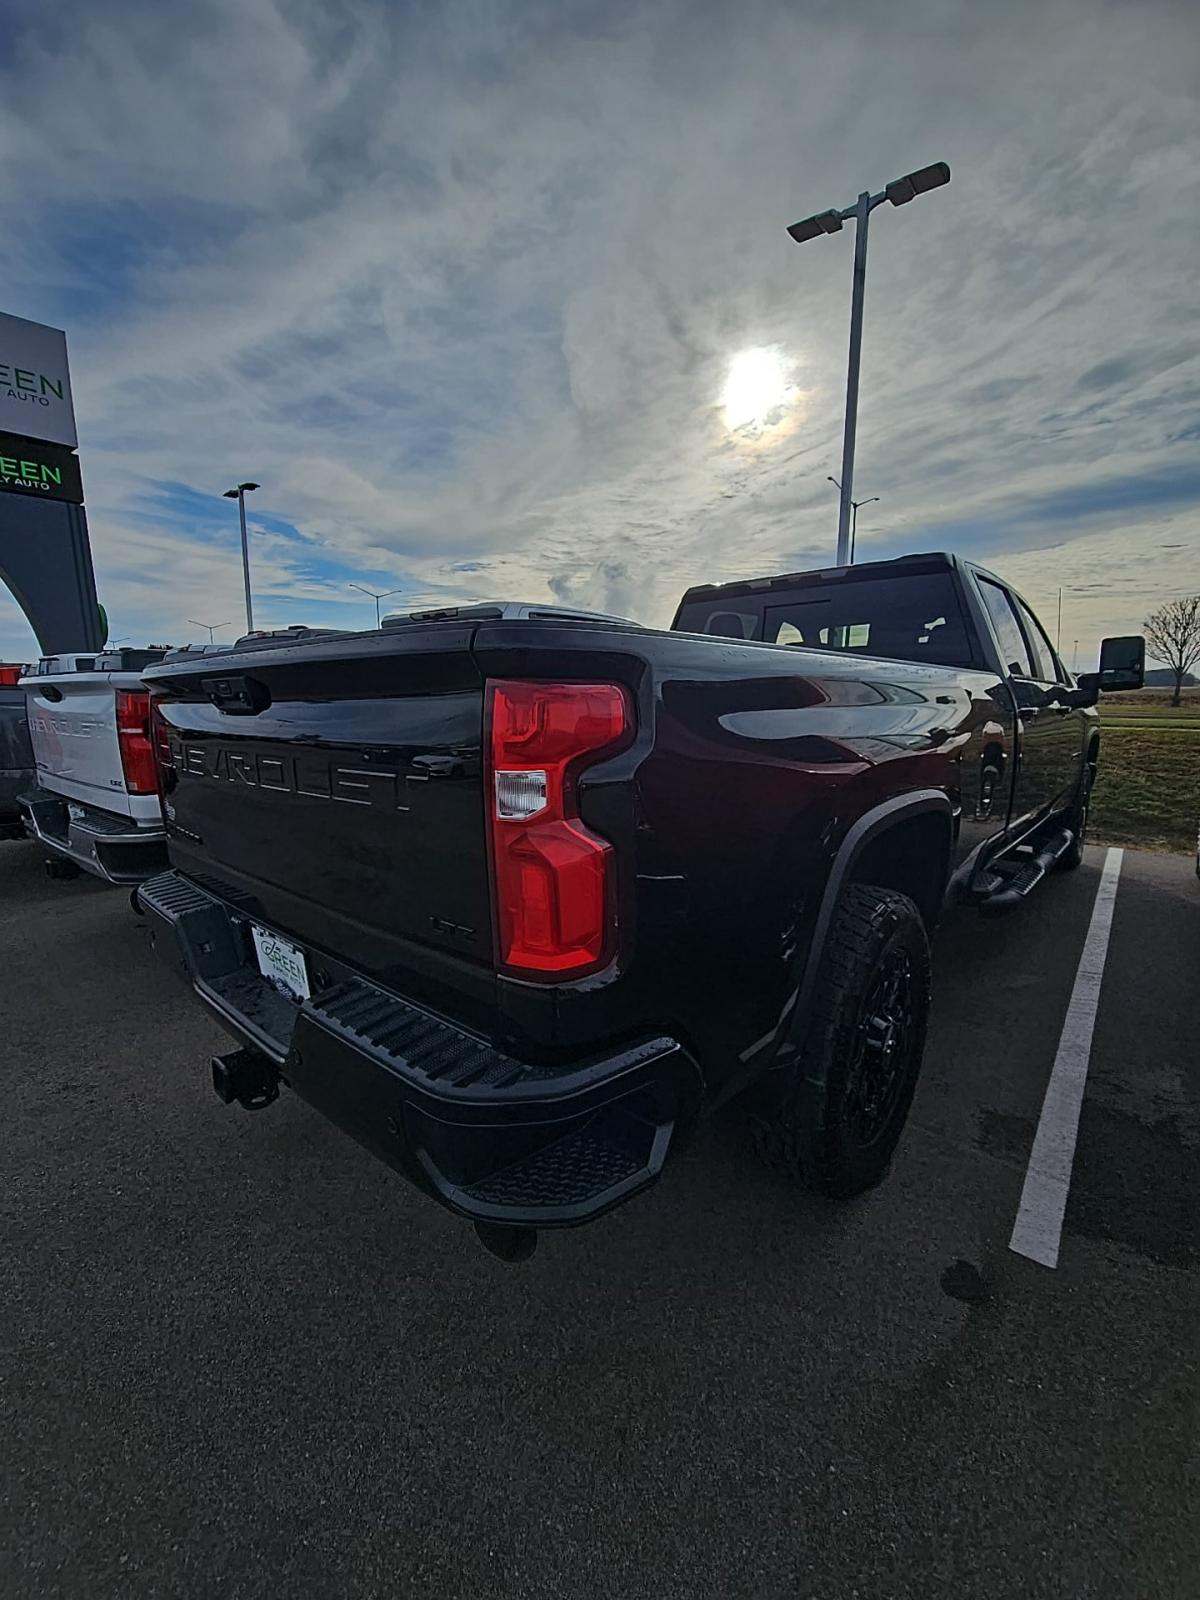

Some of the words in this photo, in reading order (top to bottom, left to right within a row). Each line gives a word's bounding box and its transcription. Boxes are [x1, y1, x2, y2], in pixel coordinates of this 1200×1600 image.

[7, 389, 50, 407] AUTO
[0, 456, 61, 485] EEN
[14, 478, 50, 491] AUTO
